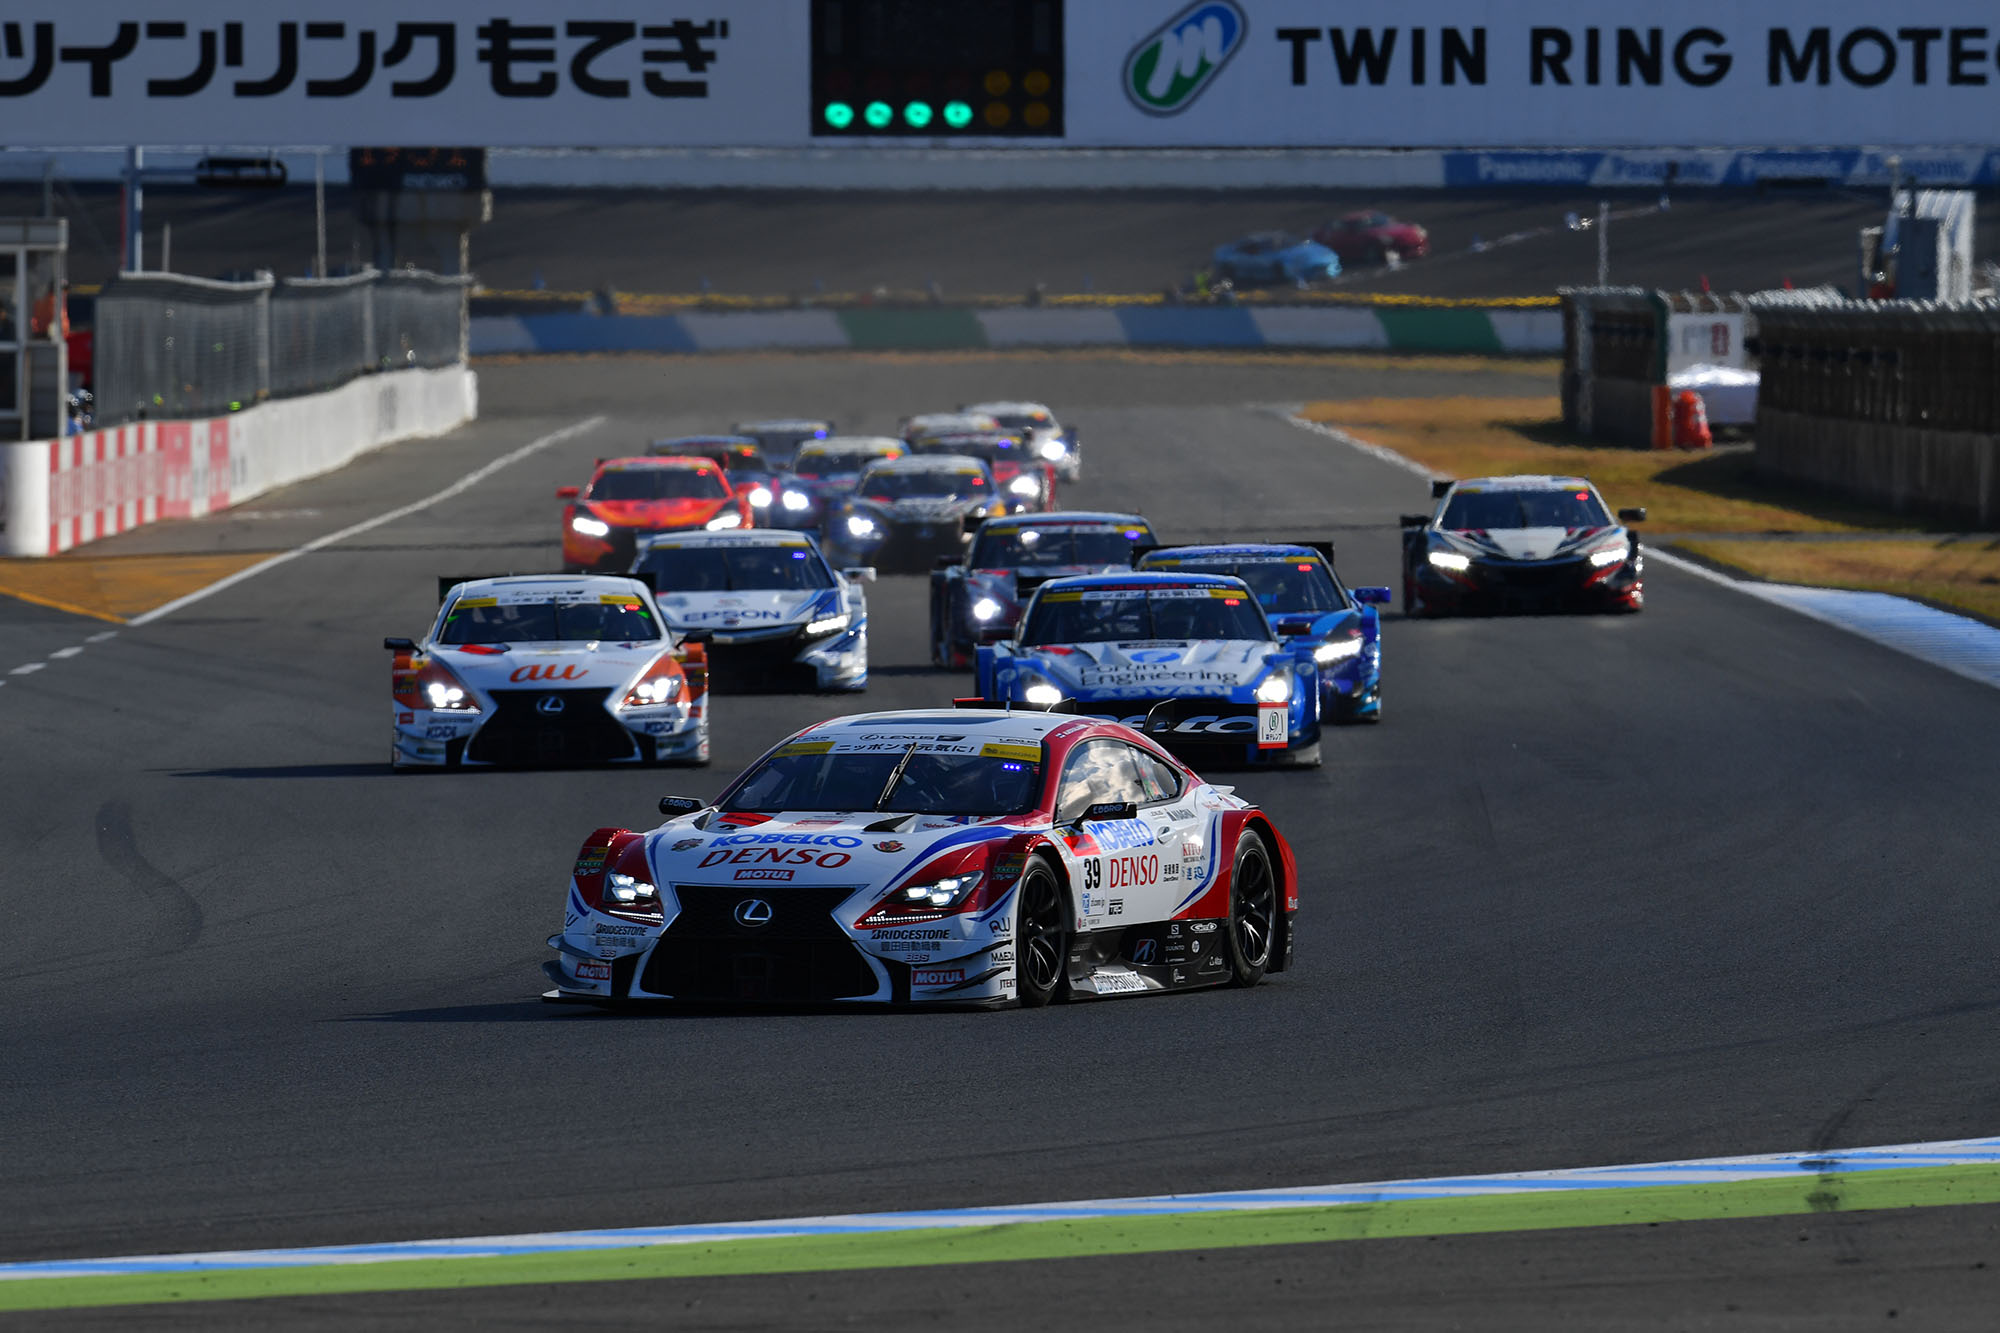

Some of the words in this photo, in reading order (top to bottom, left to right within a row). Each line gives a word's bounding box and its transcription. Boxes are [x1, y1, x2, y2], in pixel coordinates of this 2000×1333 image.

[1277, 27, 1487, 86] TWIN
[1531, 26, 1732, 88] RING
[1768, 26, 2000, 88] MOTE
[684, 609, 781, 622] EPSON
[510, 664, 588, 682] au
[1081, 663, 1168, 675] Forum
[1081, 669, 1239, 687] Engineering
[1091, 686, 1233, 698] ADVAN
[708, 833, 863, 849] KOBELCO
[1086, 818, 1155, 851] KOBELCO
[698, 847, 852, 869] DENSO
[737, 870, 793, 880] MOTUL
[1084, 857, 1101, 890] 39
[1109, 854, 1158, 888] DENSO
[595, 923, 648, 936] BRIDGESTONE
[871, 929, 950, 940] BRIDGESTONE
[905, 953, 930, 962] BBS
[577, 964, 610, 979] MOTUL
[914, 971, 962, 984] MOTUL
